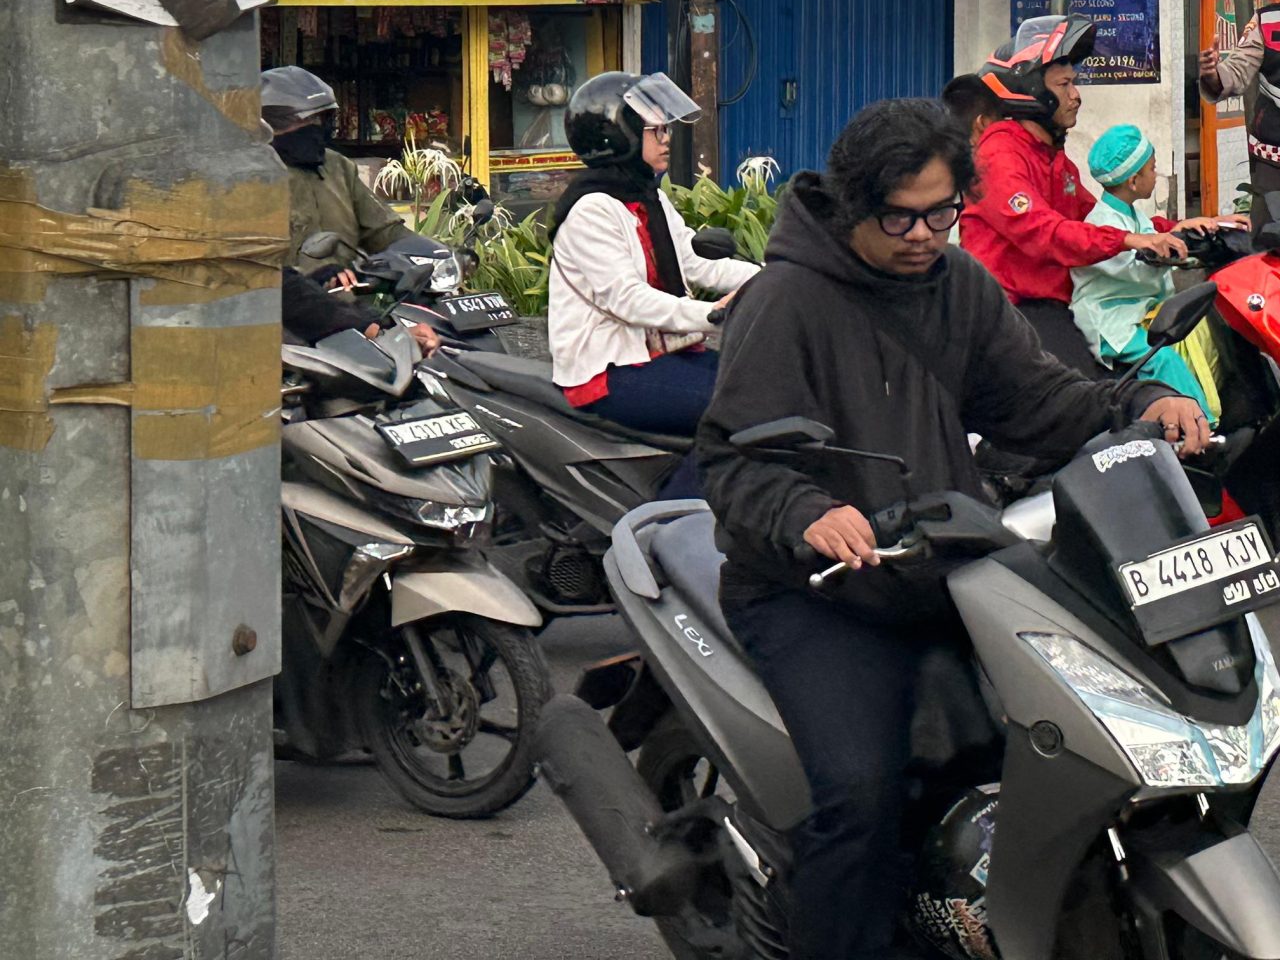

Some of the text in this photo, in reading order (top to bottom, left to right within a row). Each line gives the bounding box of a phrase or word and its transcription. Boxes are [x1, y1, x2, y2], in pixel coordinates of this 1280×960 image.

[1109, 55, 1135, 67] 6196
[1129, 531, 1262, 598] B 4418 KJY
